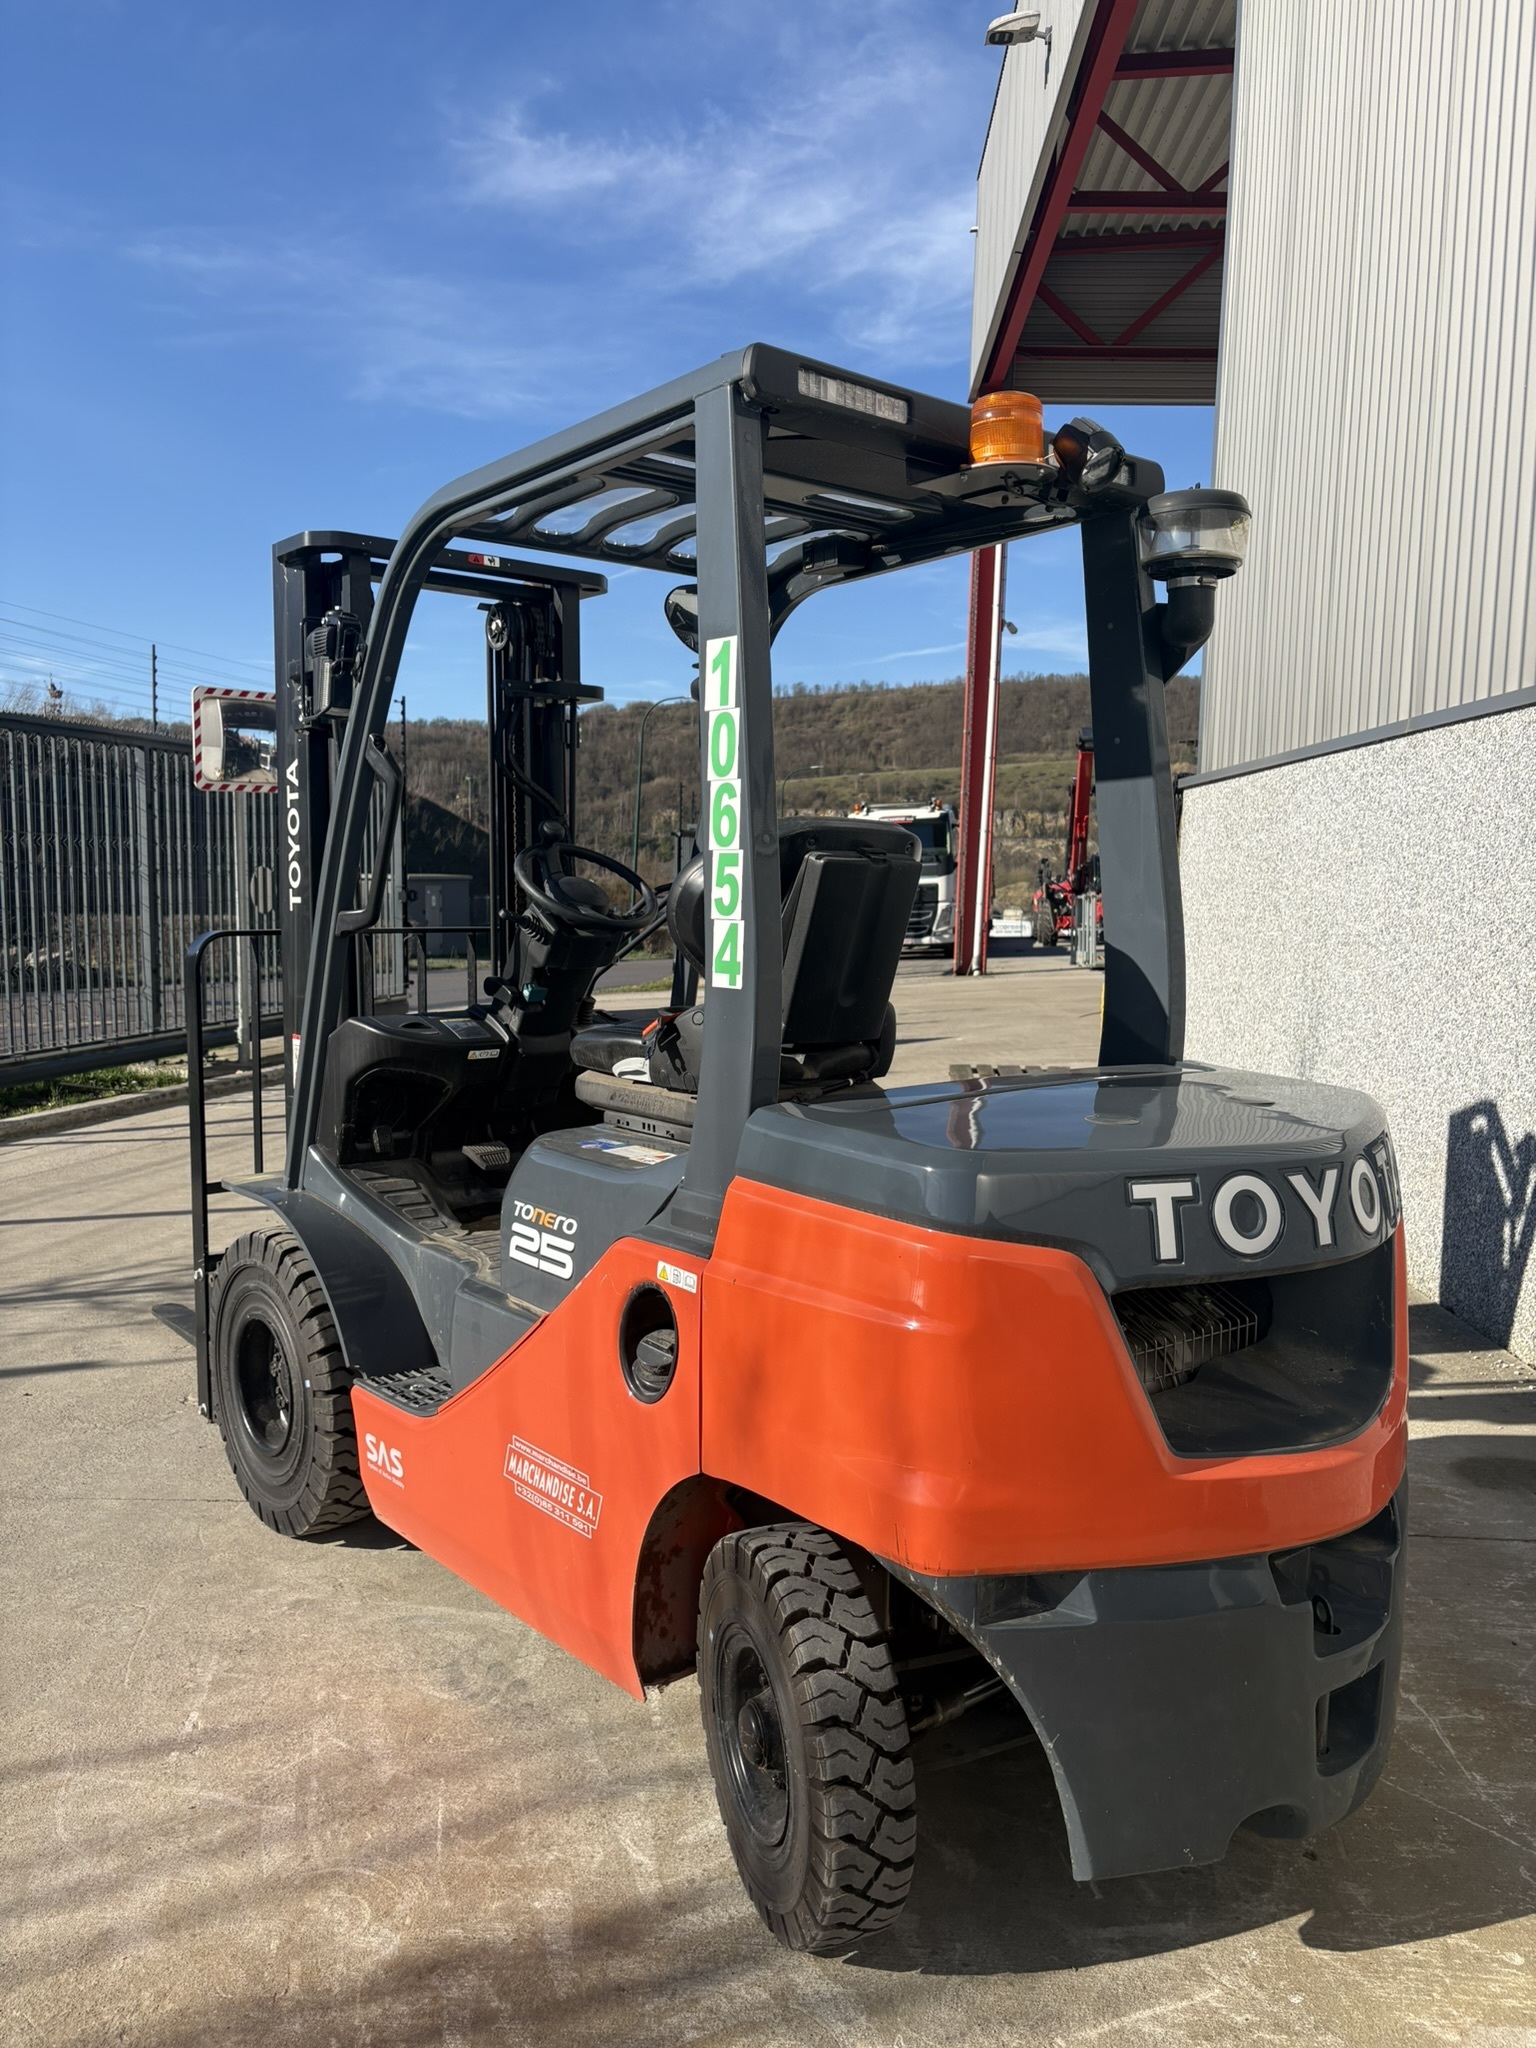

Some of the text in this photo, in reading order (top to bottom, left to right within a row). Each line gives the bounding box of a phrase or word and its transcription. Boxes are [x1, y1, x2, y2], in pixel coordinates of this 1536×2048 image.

[286, 758, 302, 912] TOYOTA
[711, 640, 741, 987] 10654
[1131, 1141, 1399, 1261] TOYOT
[509, 1221, 575, 1280] 25
[365, 1432, 404, 1478] SAS
[508, 1452, 596, 1521] MARCHANDISE S.A.
[514, 1441, 587, 1485] www.marchandise.be
[554, 1507, 570, 1522] 311
[572, 1517, 588, 1533] 591
